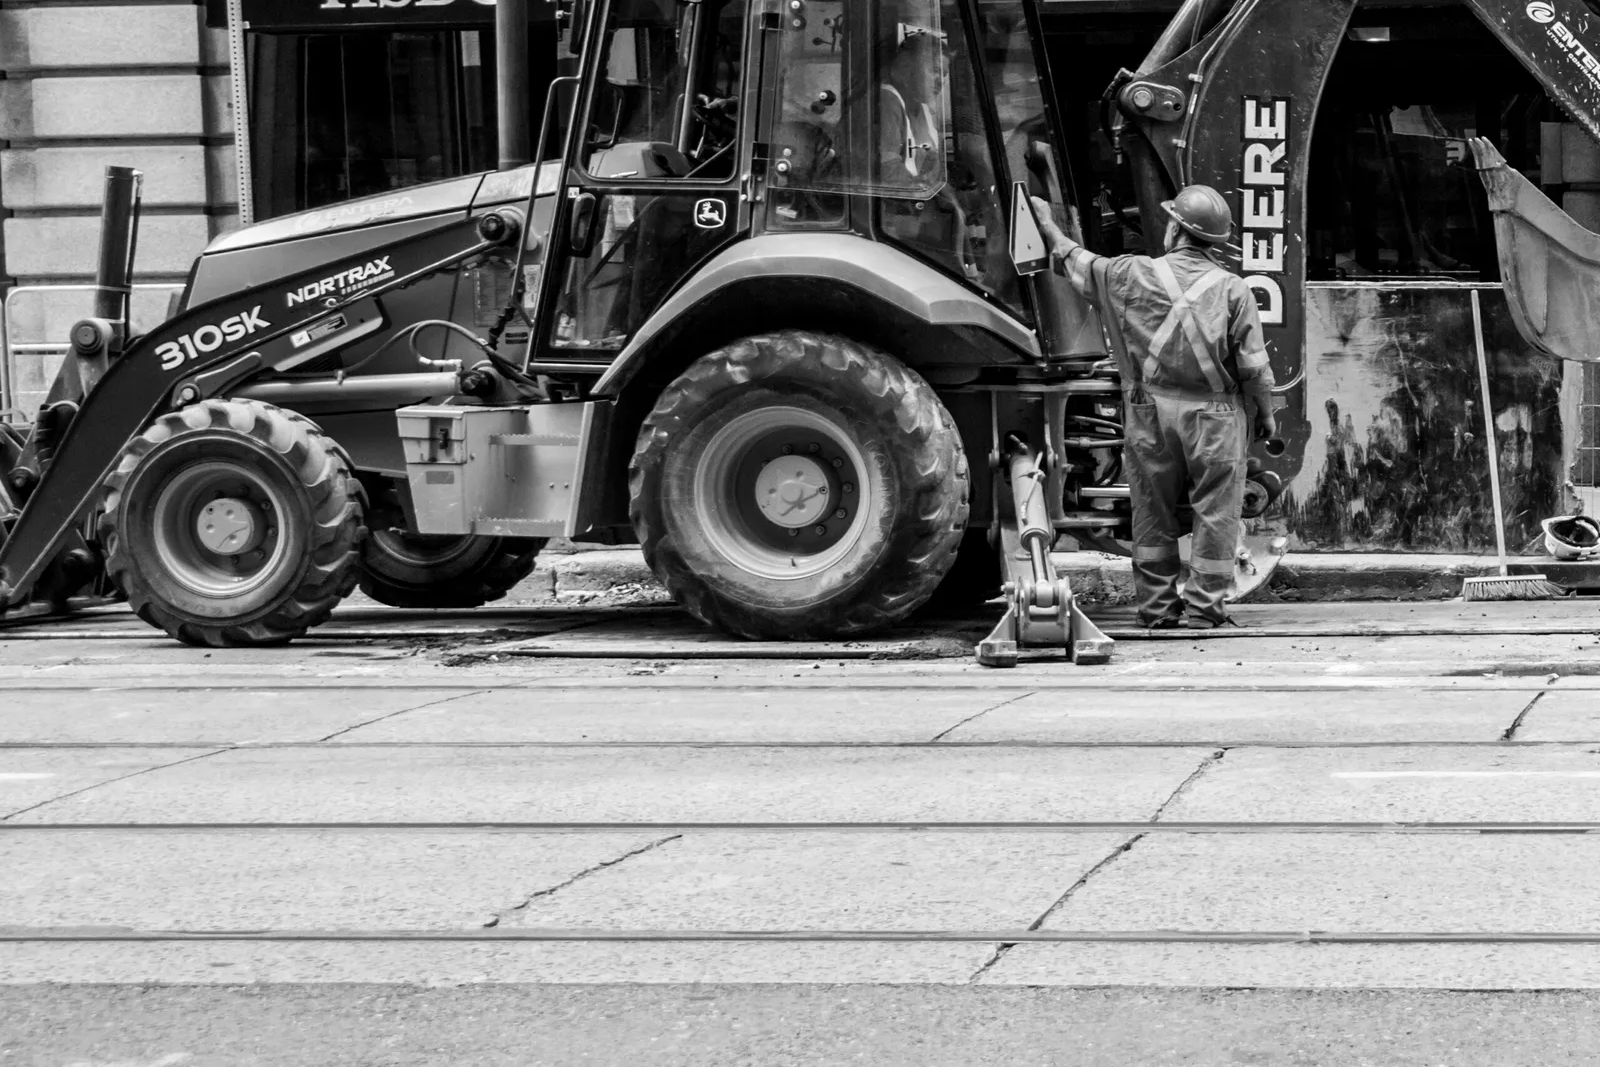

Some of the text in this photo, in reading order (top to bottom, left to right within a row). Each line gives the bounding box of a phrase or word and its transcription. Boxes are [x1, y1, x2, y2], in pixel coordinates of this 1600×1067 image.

[1546, 29, 1569, 52] UTILITY
[1242, 99, 1287, 325] DEERE
[286, 255, 393, 308] NORTRAX
[154, 305, 271, 372] 310SK
